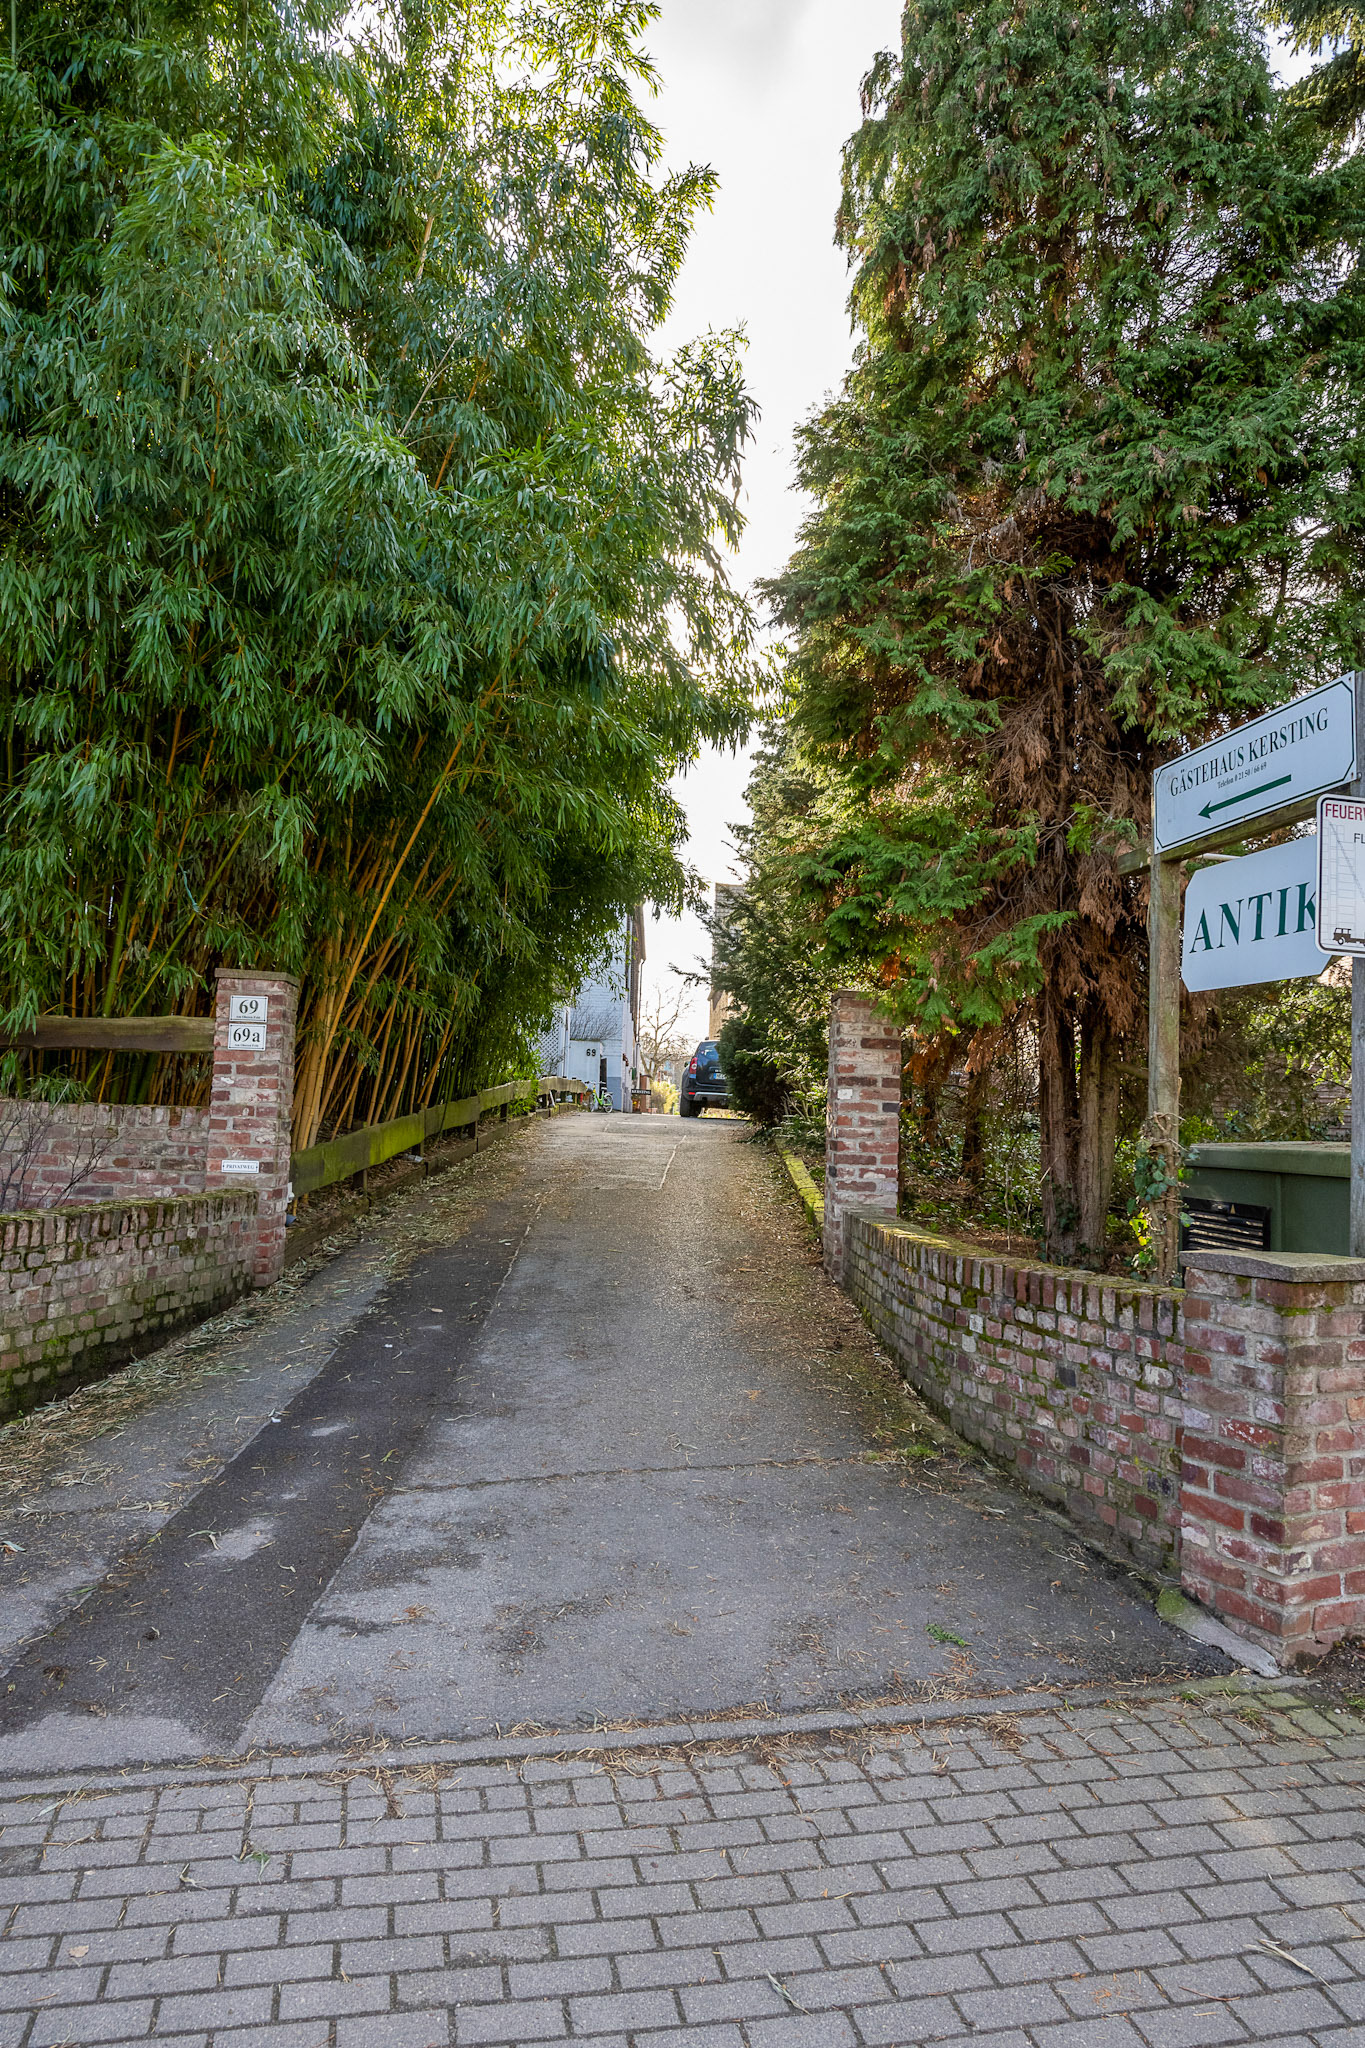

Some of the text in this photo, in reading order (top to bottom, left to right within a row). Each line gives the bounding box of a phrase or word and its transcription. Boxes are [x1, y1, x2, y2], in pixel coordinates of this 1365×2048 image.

[1170, 707, 1329, 797] GÄSTEHAUS KERSTING
[1217, 776, 1234, 789] Telefon
[1189, 882, 1316, 954] ANTIK
[239, 1000, 259, 1014] 69
[233, 1027, 260, 1042] 69a
[586, 1049, 596, 1057] 69
